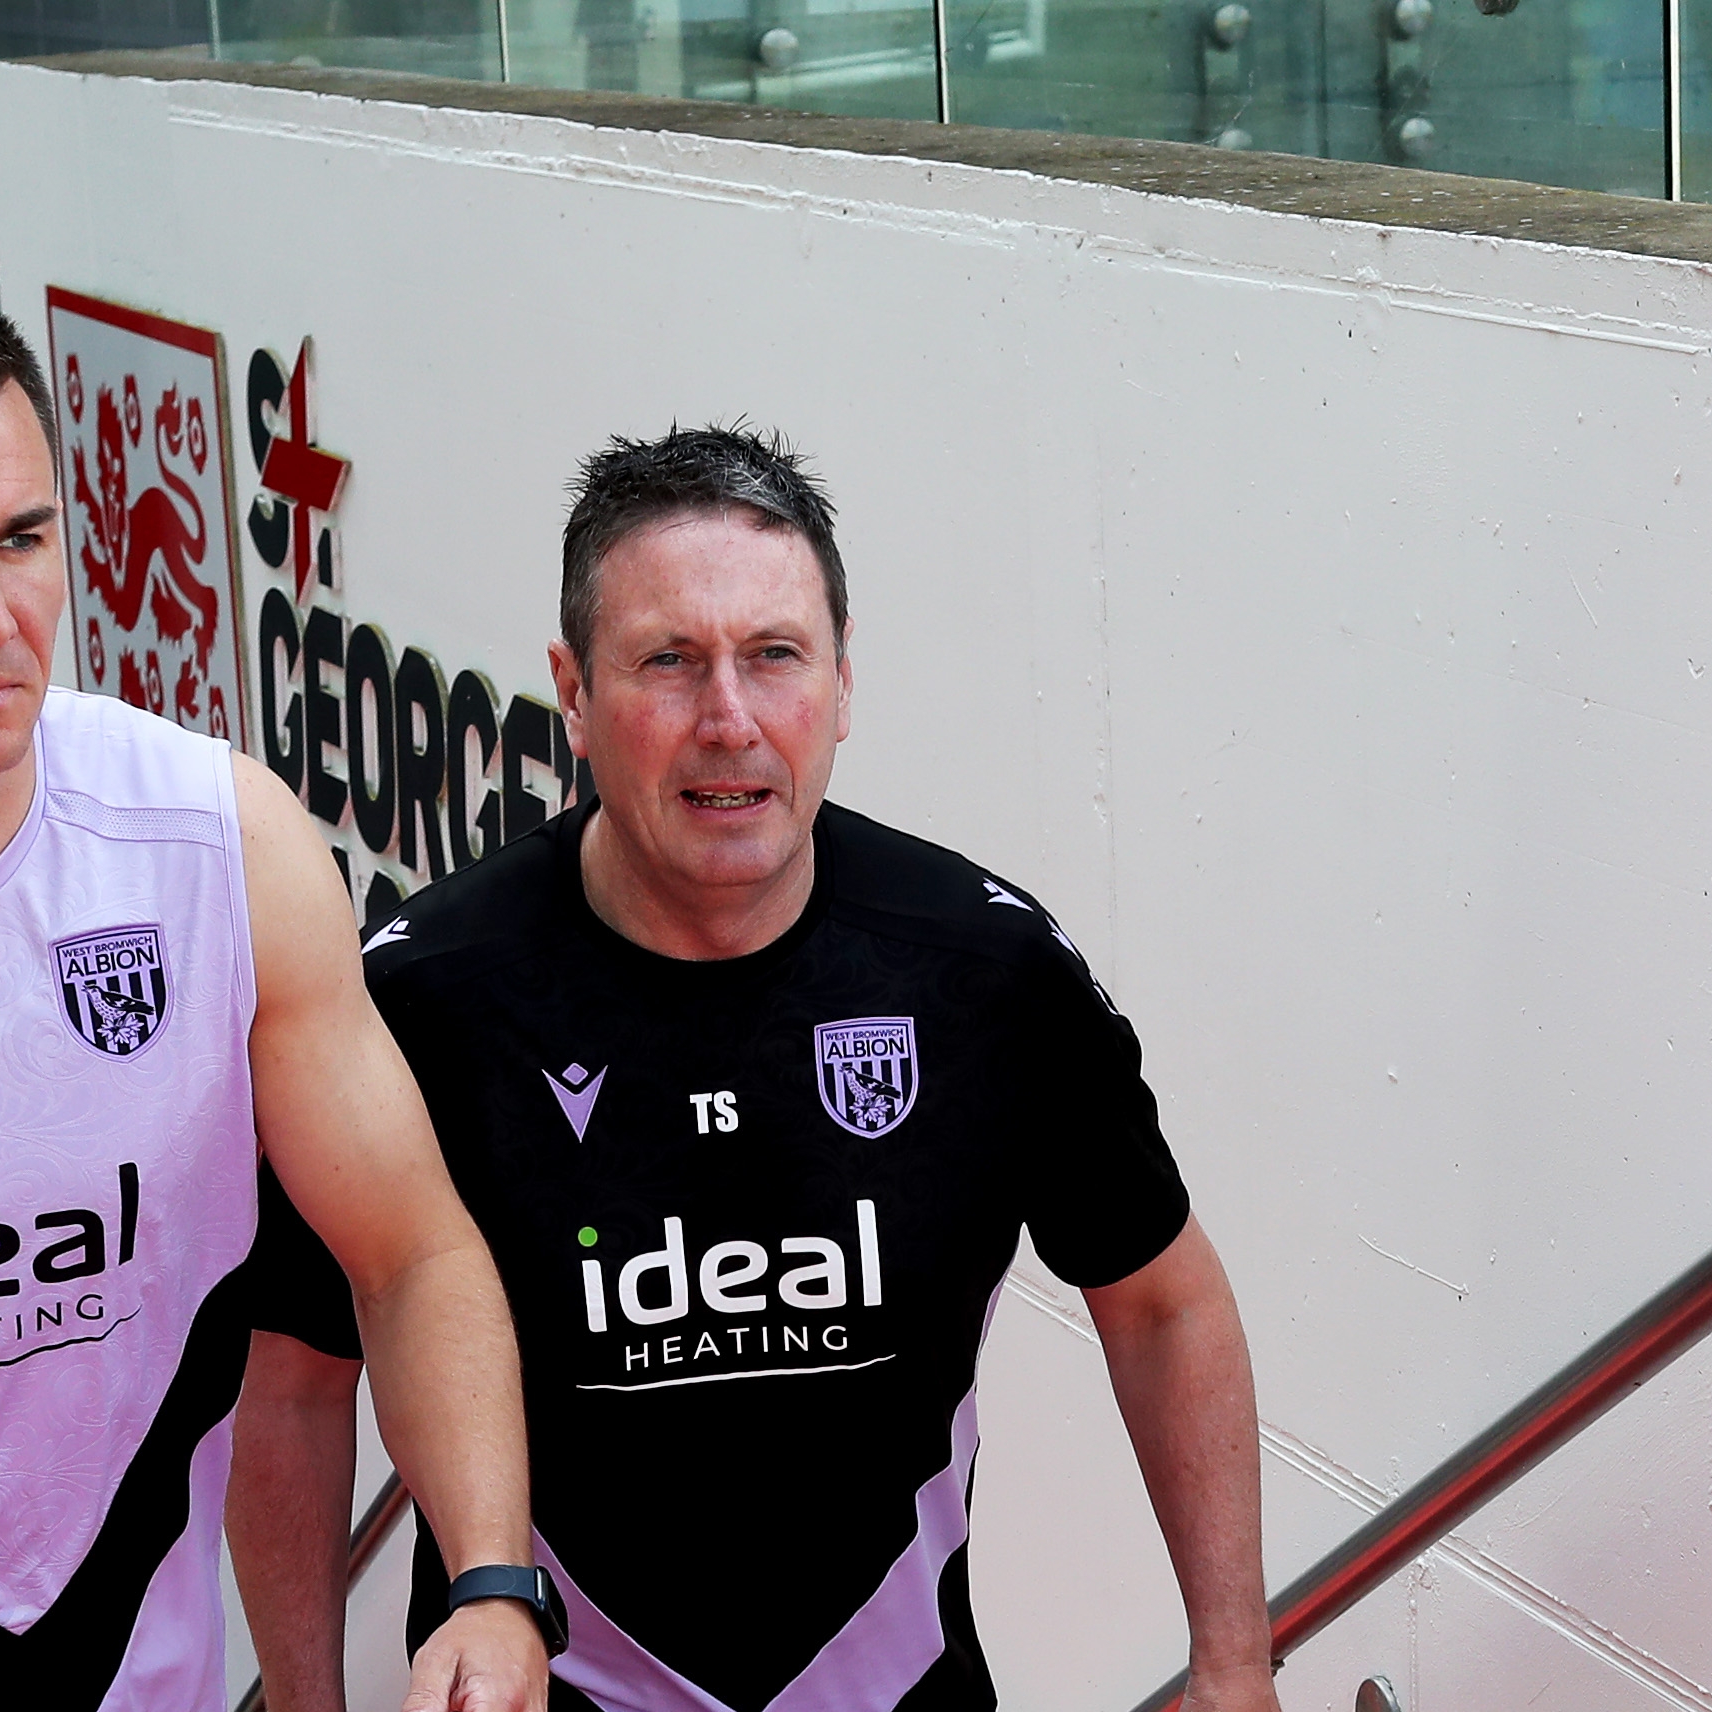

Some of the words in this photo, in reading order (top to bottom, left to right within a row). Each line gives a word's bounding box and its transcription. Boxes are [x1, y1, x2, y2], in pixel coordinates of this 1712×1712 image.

[62, 946, 92, 958] WEST
[95, 936, 153, 954] BROMWICH
[65, 944, 155, 980] ALBION
[825, 1031, 850, 1041] WEST
[853, 1028, 903, 1040] BROMWICH
[827, 1036, 905, 1060] ALBION
[689, 1090, 739, 1134] TS
[577, 1198, 882, 1333] ideal
[625, 1325, 849, 1371] HEATING
